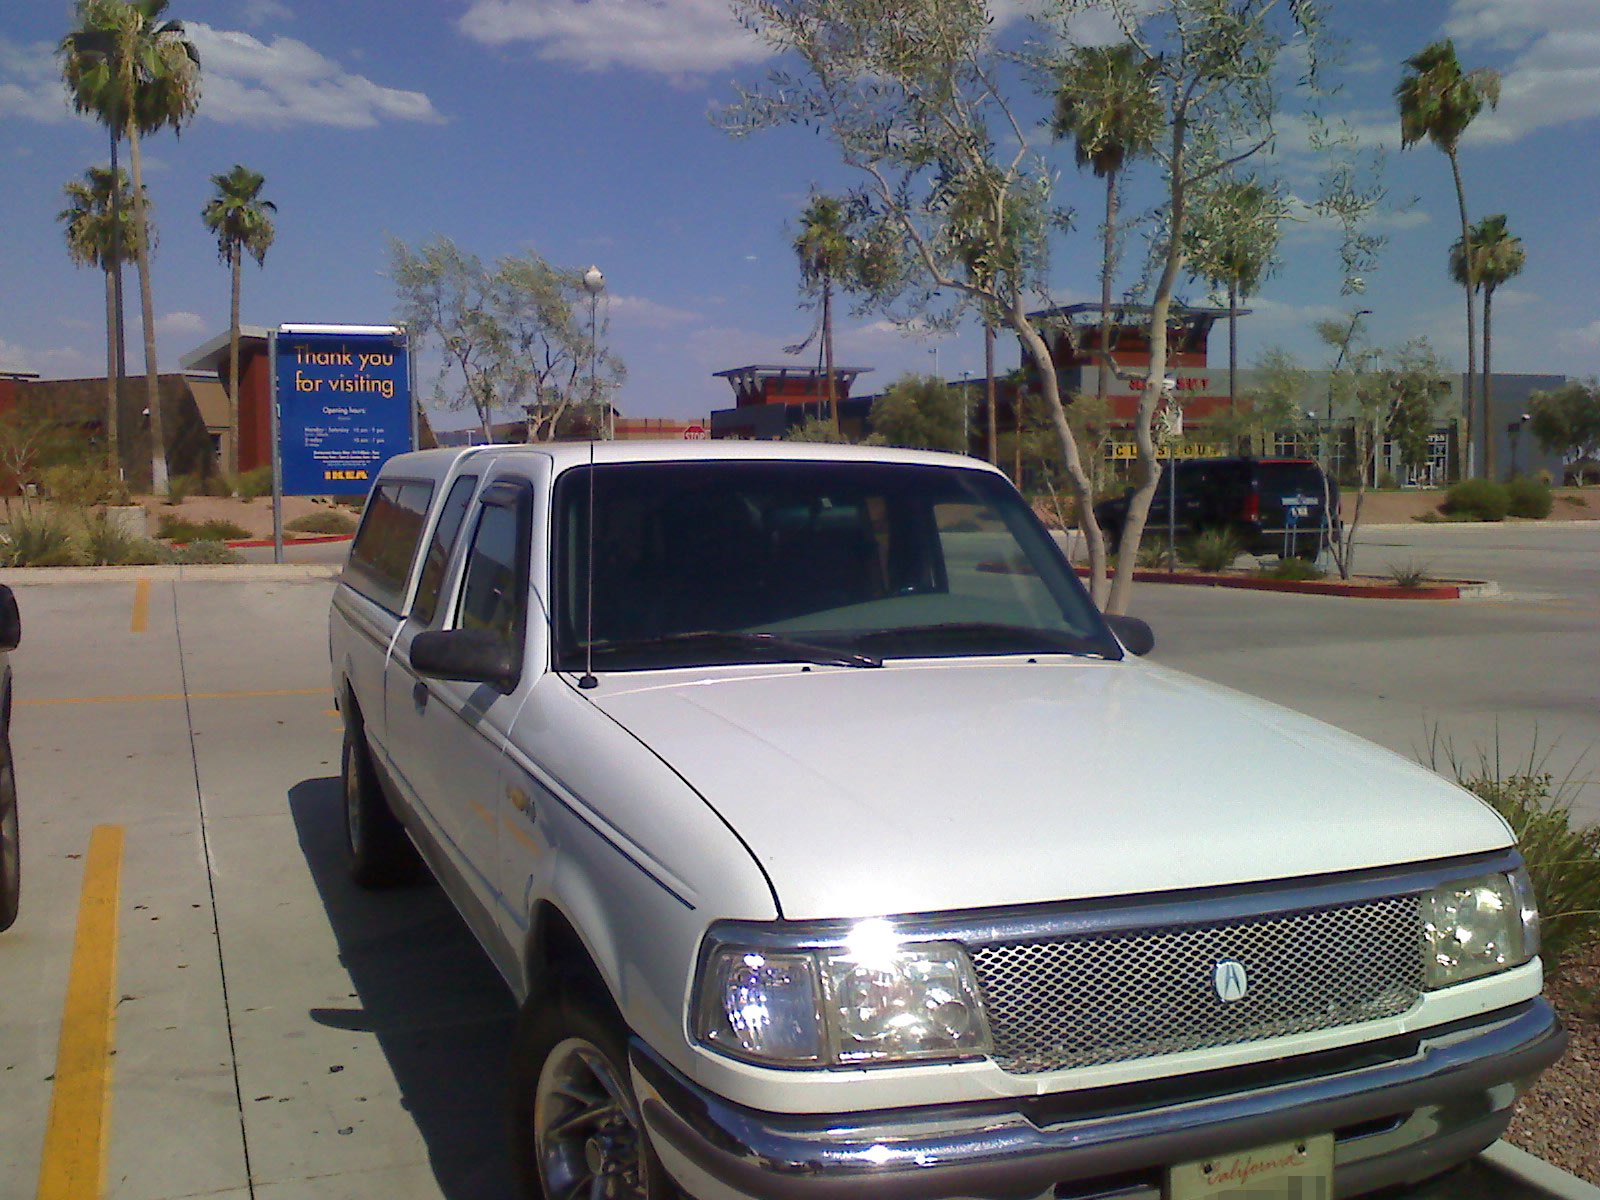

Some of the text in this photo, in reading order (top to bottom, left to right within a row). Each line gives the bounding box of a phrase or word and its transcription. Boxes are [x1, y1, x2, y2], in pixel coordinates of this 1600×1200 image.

[294, 344, 394, 371] Thank you
[295, 370, 394, 398] for visiting
[685, 432, 705, 440] STOP
[324, 470, 368, 480] IKEA
[1206, 1153, 1304, 1186] California
